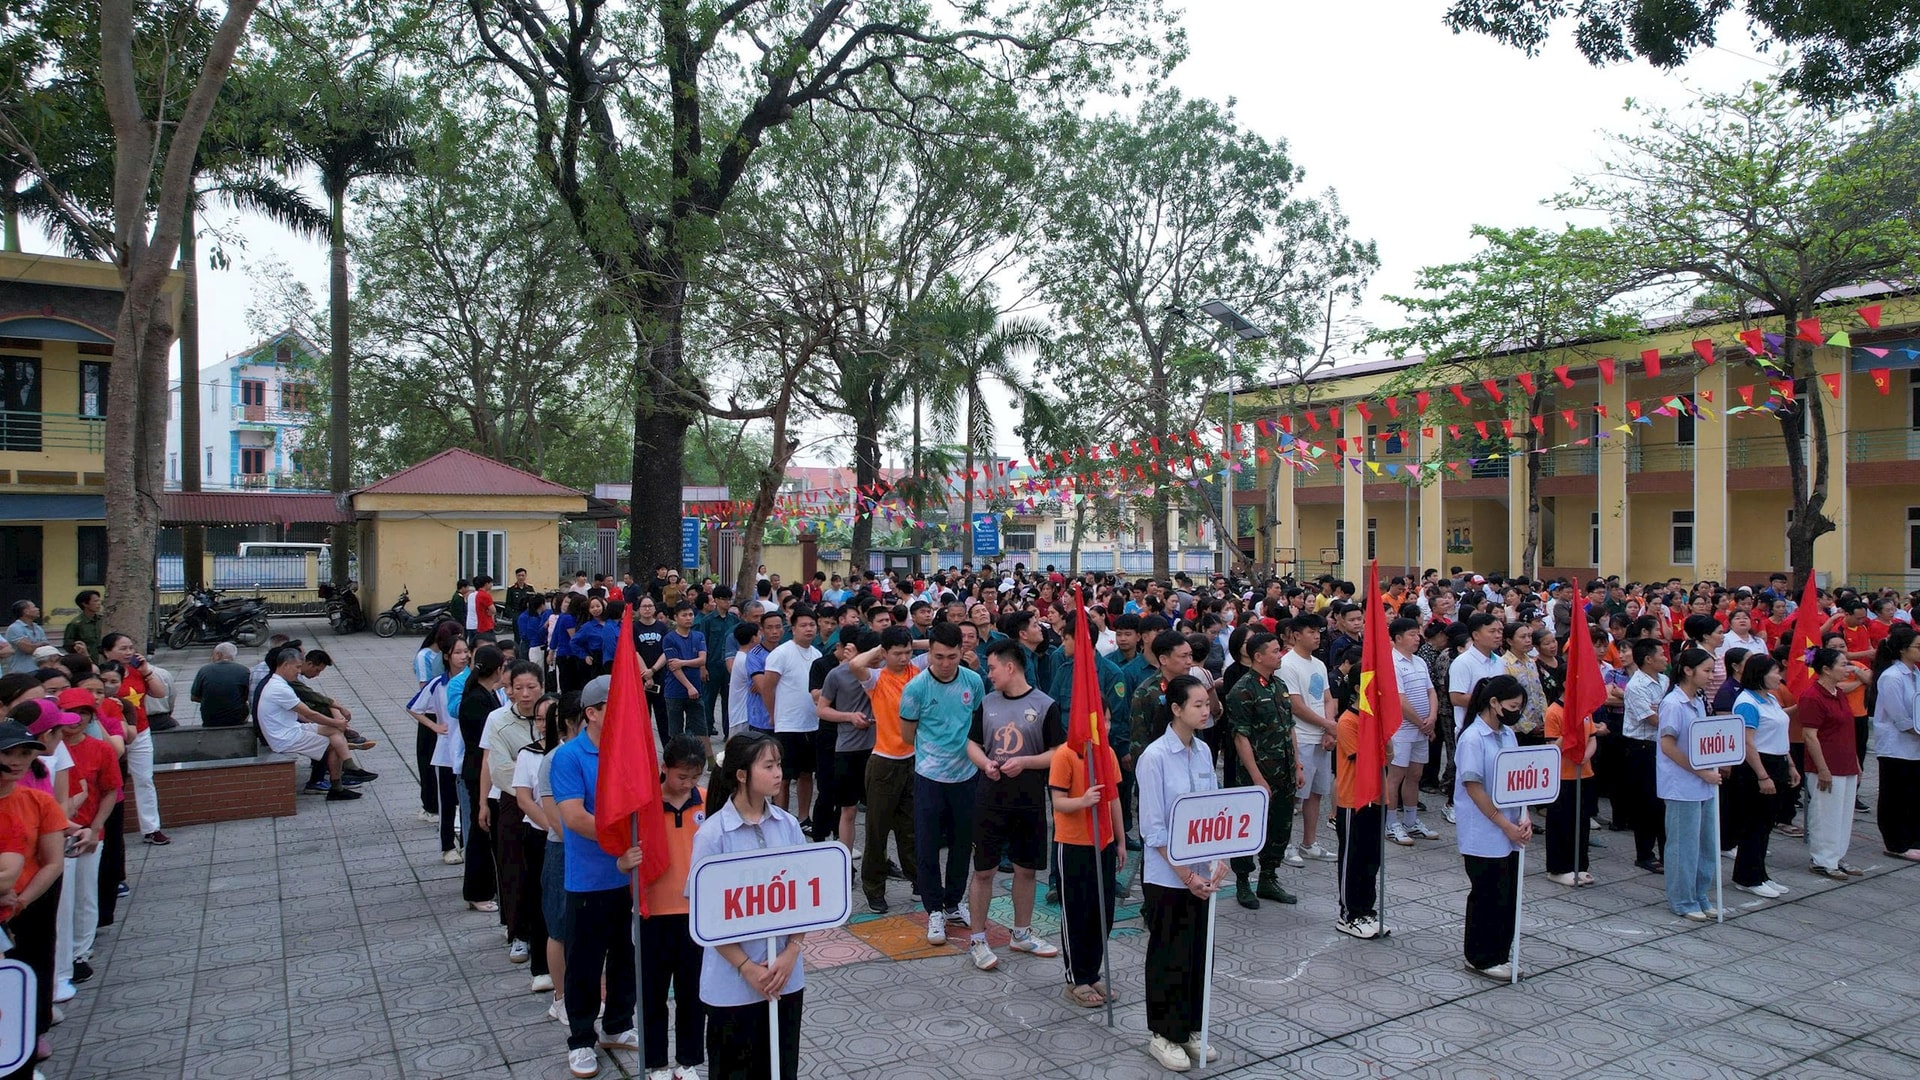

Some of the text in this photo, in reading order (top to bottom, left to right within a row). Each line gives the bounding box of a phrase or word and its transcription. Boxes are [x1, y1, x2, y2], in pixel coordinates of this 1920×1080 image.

[1699, 729, 1735, 756] KHỐI 4
[1507, 761, 1549, 791] KHỐI 3
[1187, 807, 1250, 844] KHỐI 2
[724, 870, 821, 920] KHỐI 1
